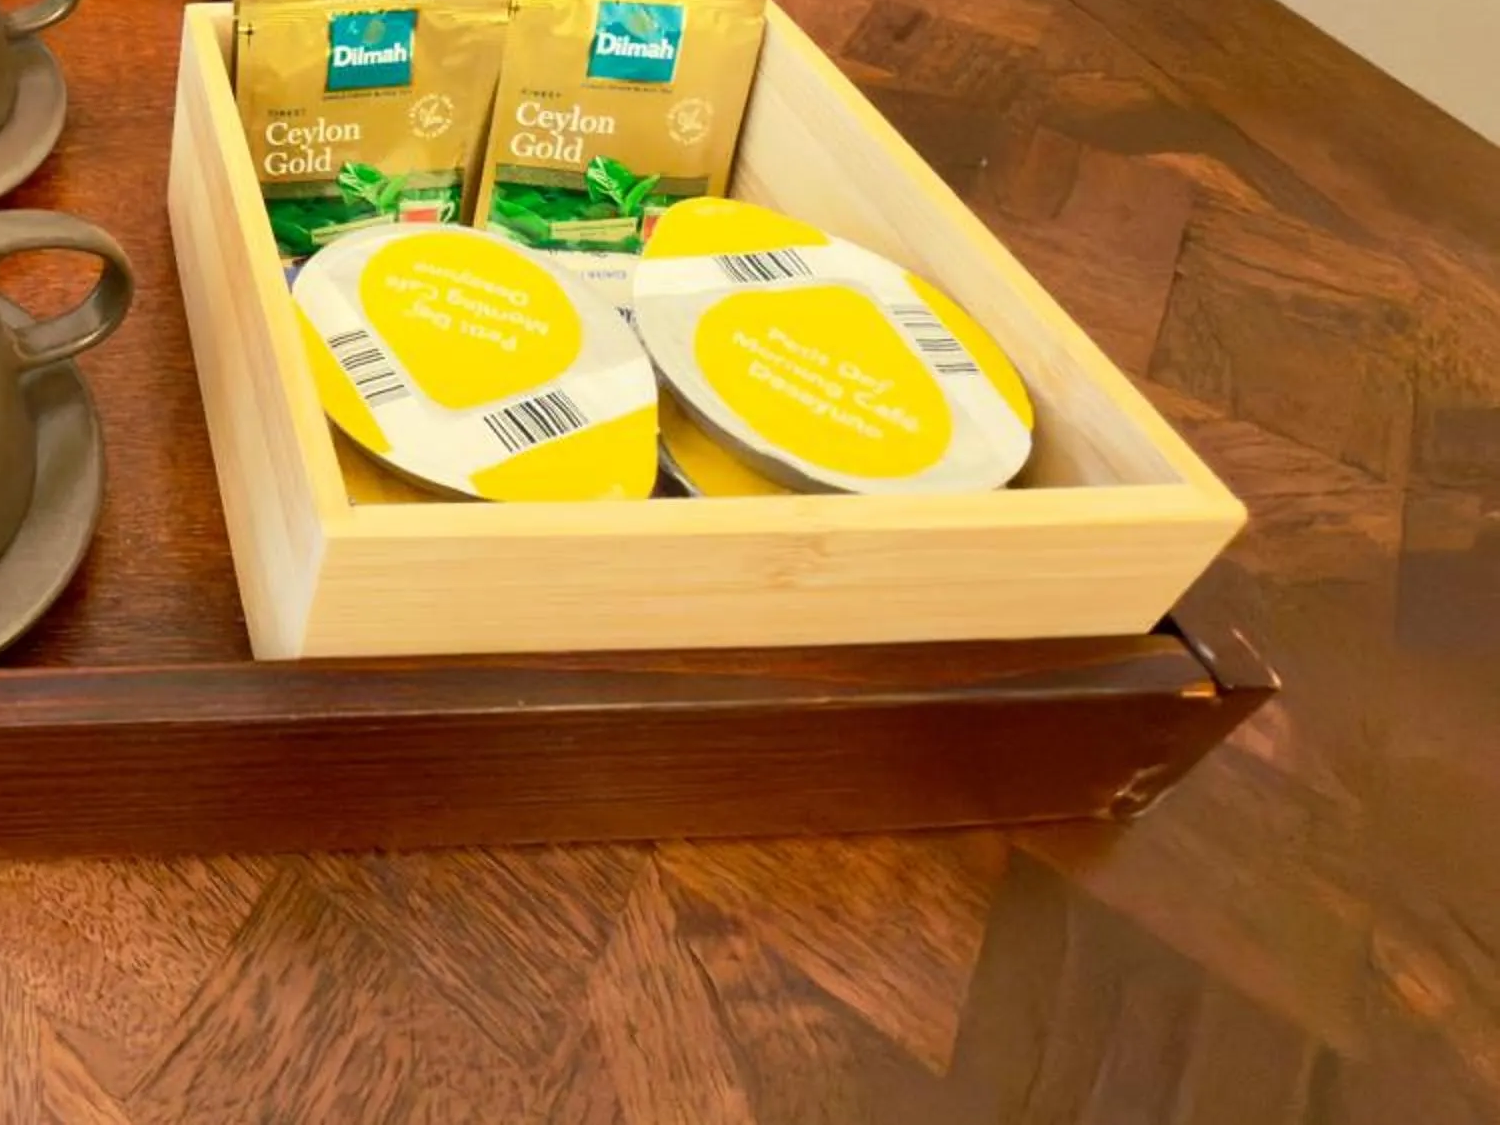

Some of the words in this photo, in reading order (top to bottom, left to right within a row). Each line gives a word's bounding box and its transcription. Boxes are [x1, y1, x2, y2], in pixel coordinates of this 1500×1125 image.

[332, 43, 408, 68] Dilmah
[595, 29, 675, 60] Dilmah
[265, 118, 362, 150] Ceylon
[515, 102, 617, 135] Ceylon
[263, 147, 332, 176] Gold
[510, 132, 584, 163] Gold
